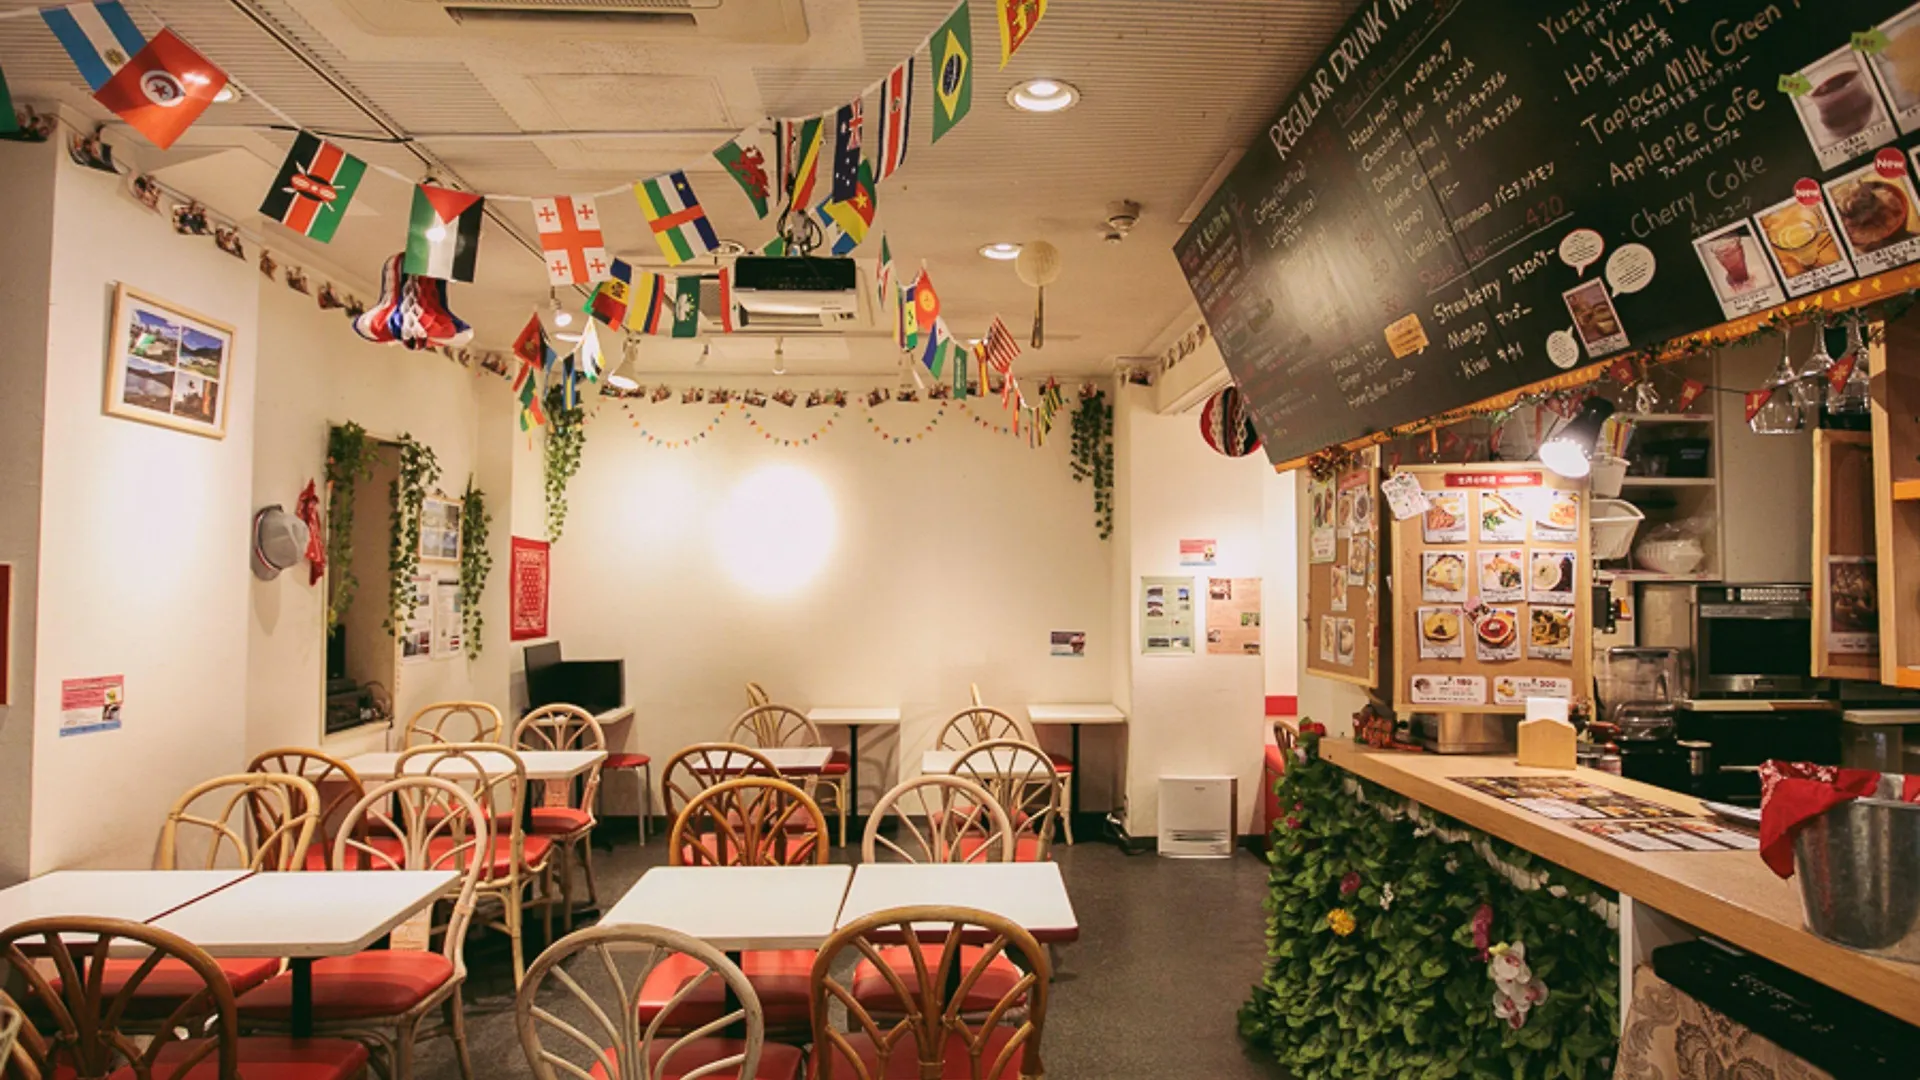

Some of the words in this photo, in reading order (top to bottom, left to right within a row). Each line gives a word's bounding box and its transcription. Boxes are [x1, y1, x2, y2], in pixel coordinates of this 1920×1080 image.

[1538, 1, 1592, 44] Yuzu
[1268, 67, 1334, 160] REGULAR
[1328, 2, 1388, 84] DRINK
[1564, 52, 1602, 95] Hot
[1600, 14, 1658, 61] Yuzu
[1580, 81, 1667, 144] Tapioca
[1665, 45, 1712, 91] Milk
[1710, 3, 1782, 55] Green
[1350, 95, 1400, 149] Hazelnuts
[1361, 125, 1403, 171] Chocolate
[1609, 118, 1701, 186] Applepie
[1704, 87, 1766, 133] Cafe
[1631, 192, 1698, 238] Cherry
[1706, 154, 1767, 199] Coke
[1432, 279, 1501, 326] Strawberry
[1447, 320, 1488, 350] Mango
[1460, 355, 1491, 380] Kiwi
